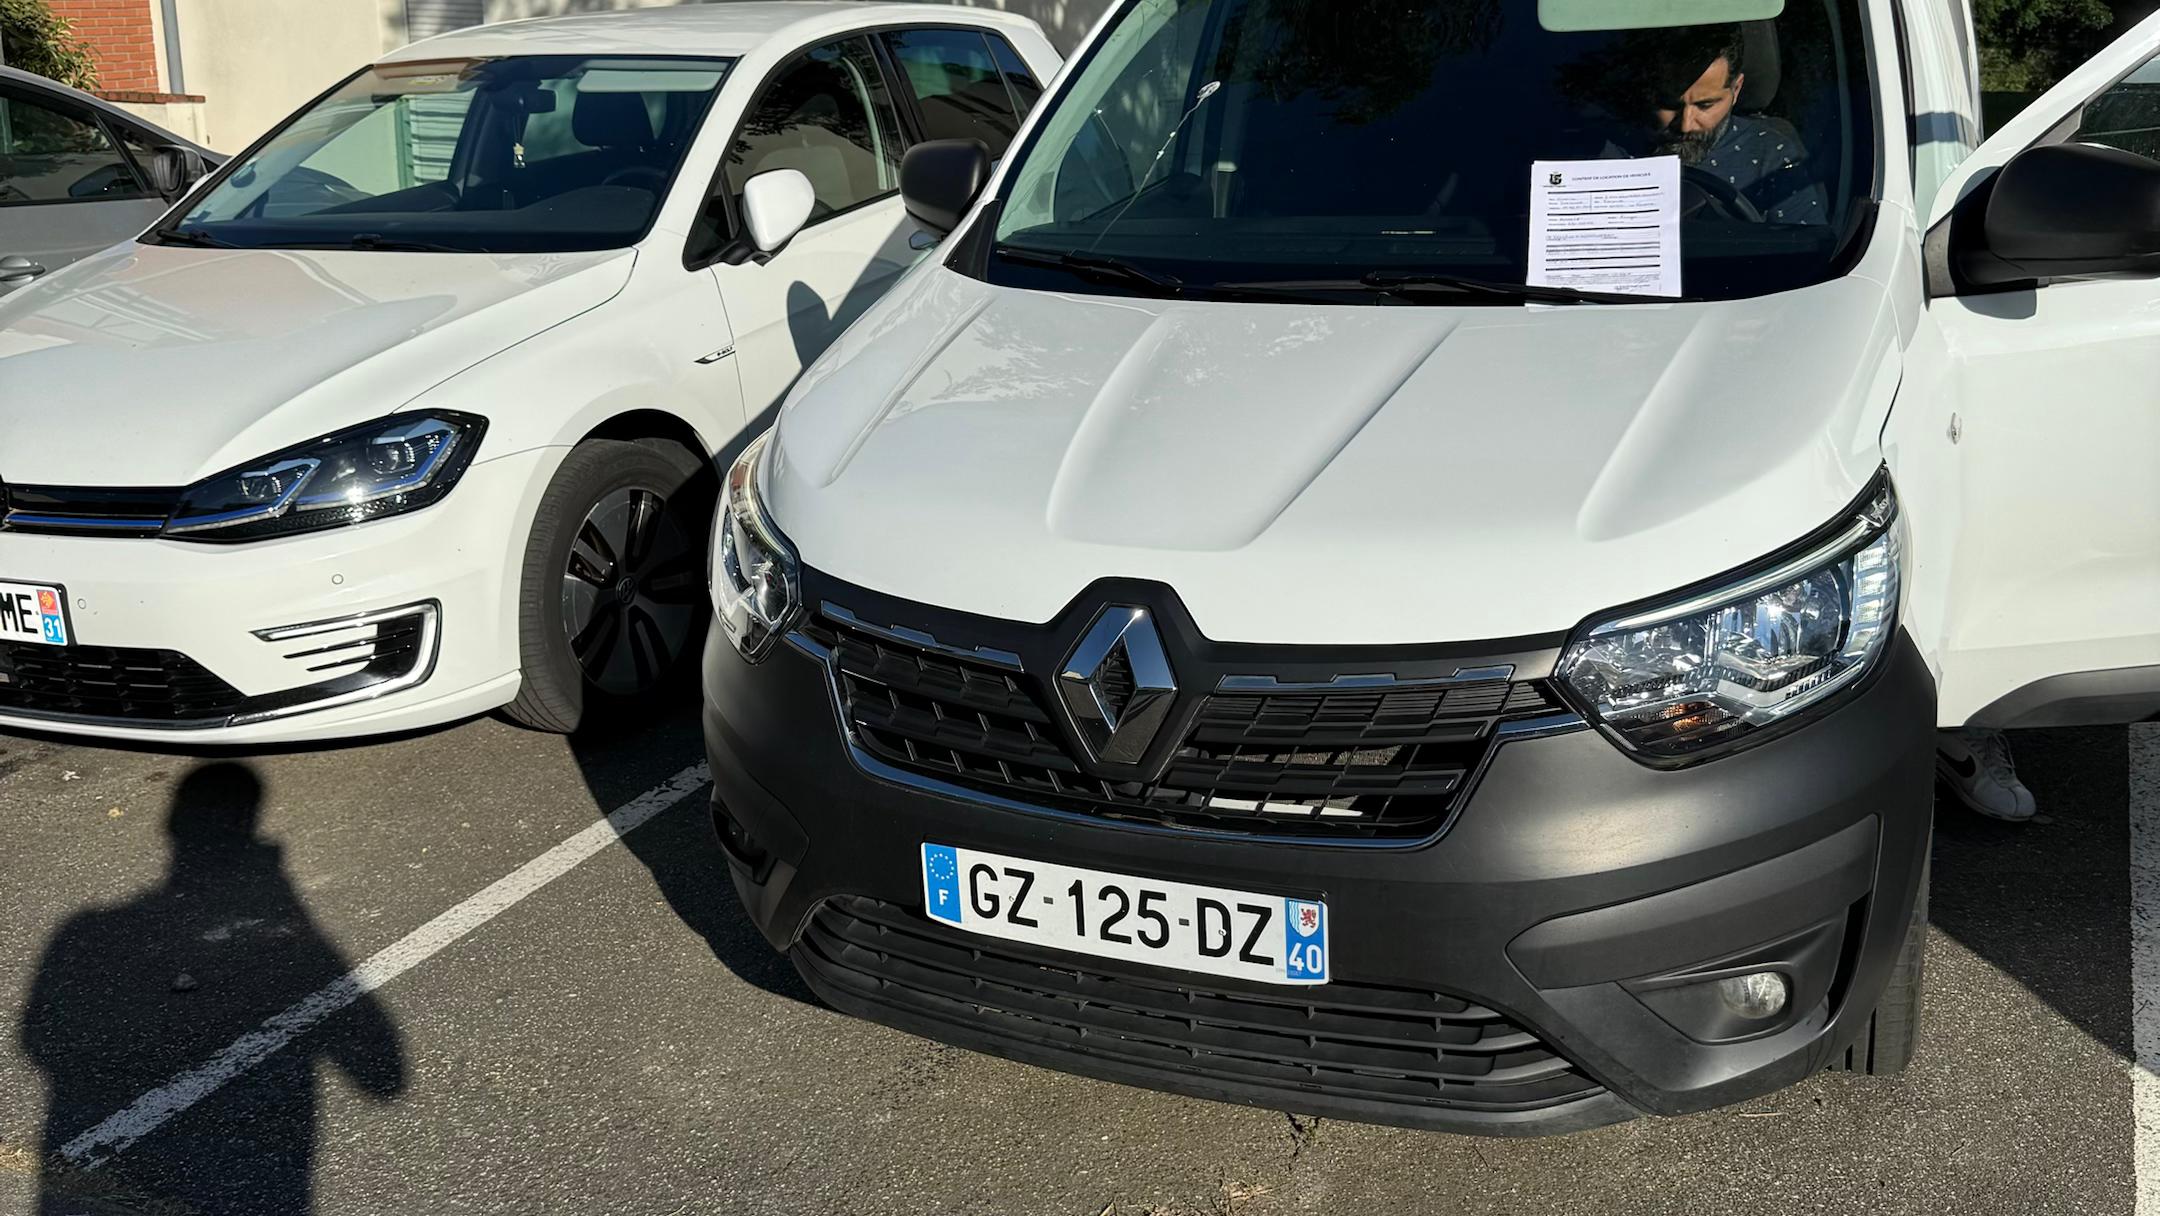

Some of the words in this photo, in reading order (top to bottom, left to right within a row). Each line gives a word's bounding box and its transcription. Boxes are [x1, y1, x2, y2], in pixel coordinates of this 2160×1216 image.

[0, 592, 39, 634] ME
[44, 617, 63, 639] 31
[938, 889, 949, 906] F
[969, 863, 1275, 966] GZ-125-DZ
[1288, 942, 1323, 974] 40
